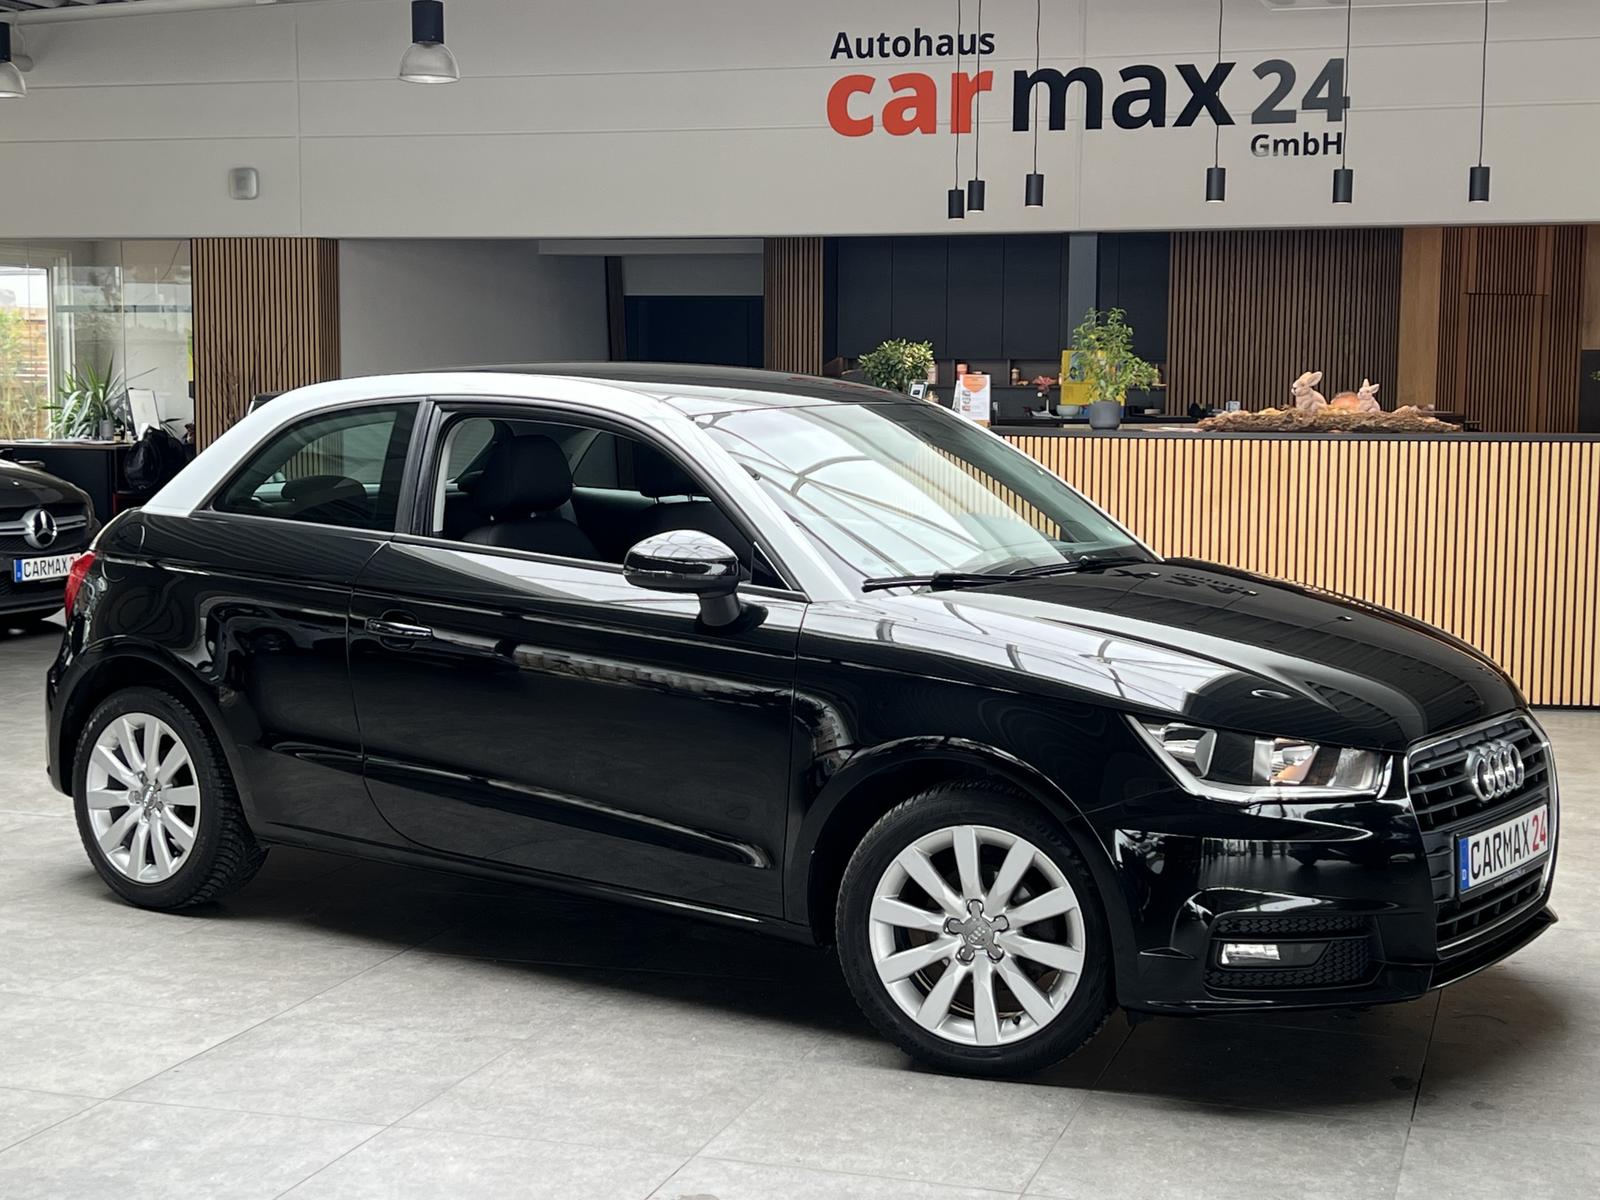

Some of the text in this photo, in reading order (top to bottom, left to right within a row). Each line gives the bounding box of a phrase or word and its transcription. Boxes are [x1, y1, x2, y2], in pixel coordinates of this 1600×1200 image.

[830, 28, 996, 60] Autohaus
[826, 57, 1351, 138] car max 24
[1250, 131, 1343, 158] GmbH
[24, 556, 80, 578] CARMAX
